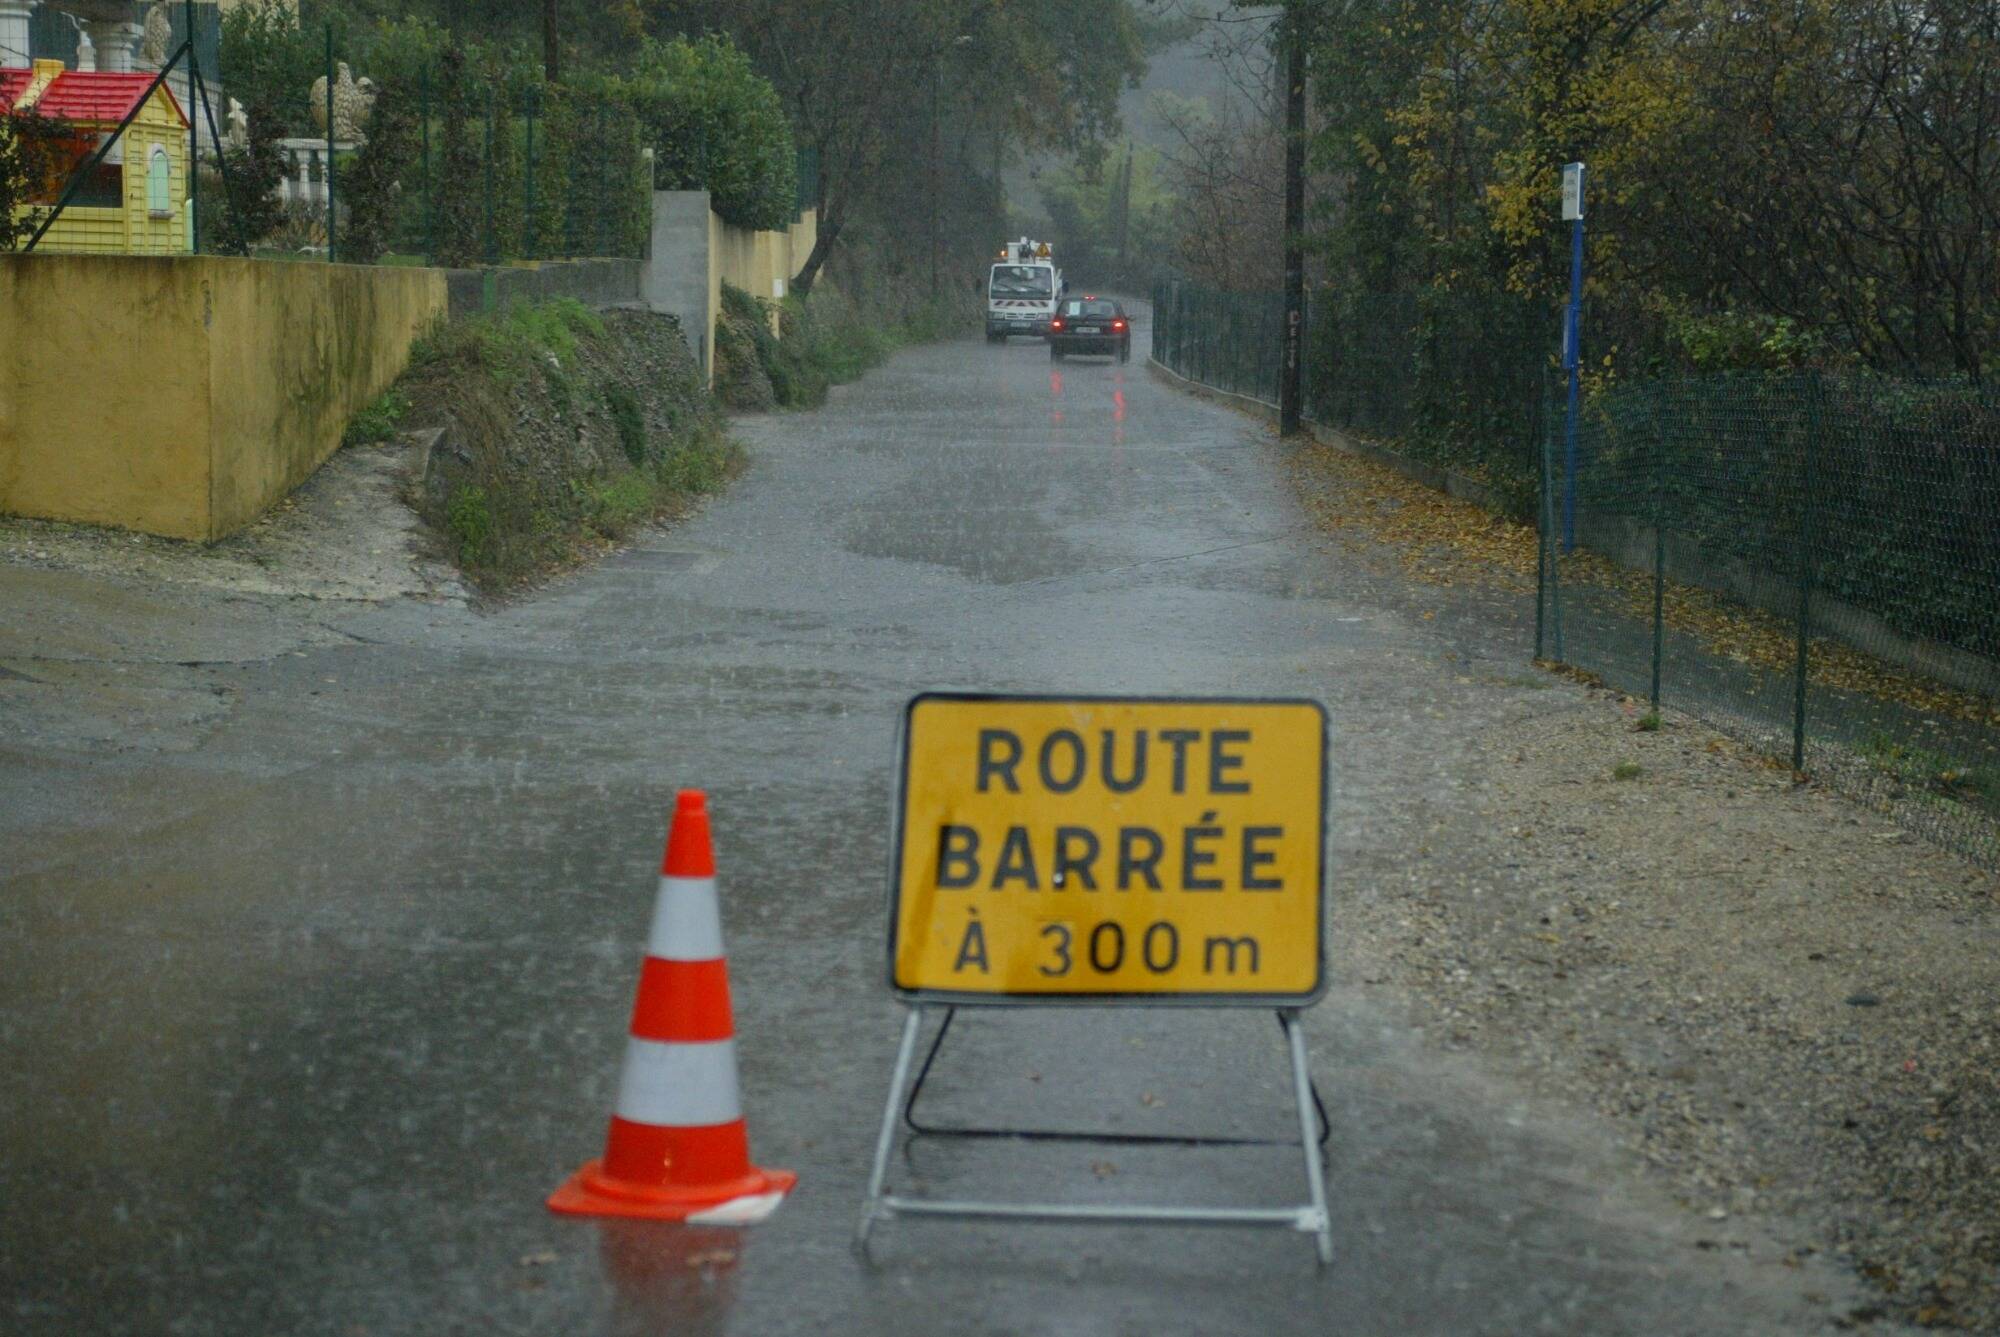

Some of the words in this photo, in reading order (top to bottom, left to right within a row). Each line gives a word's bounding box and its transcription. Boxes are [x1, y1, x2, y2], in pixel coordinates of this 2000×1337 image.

[976, 729, 1252, 795] ROUTE
[936, 811, 1284, 891] BARRÉE
[954, 907, 990, 974] À
[1038, 922, 1180, 978] 300
[1204, 935, 1260, 974] m
